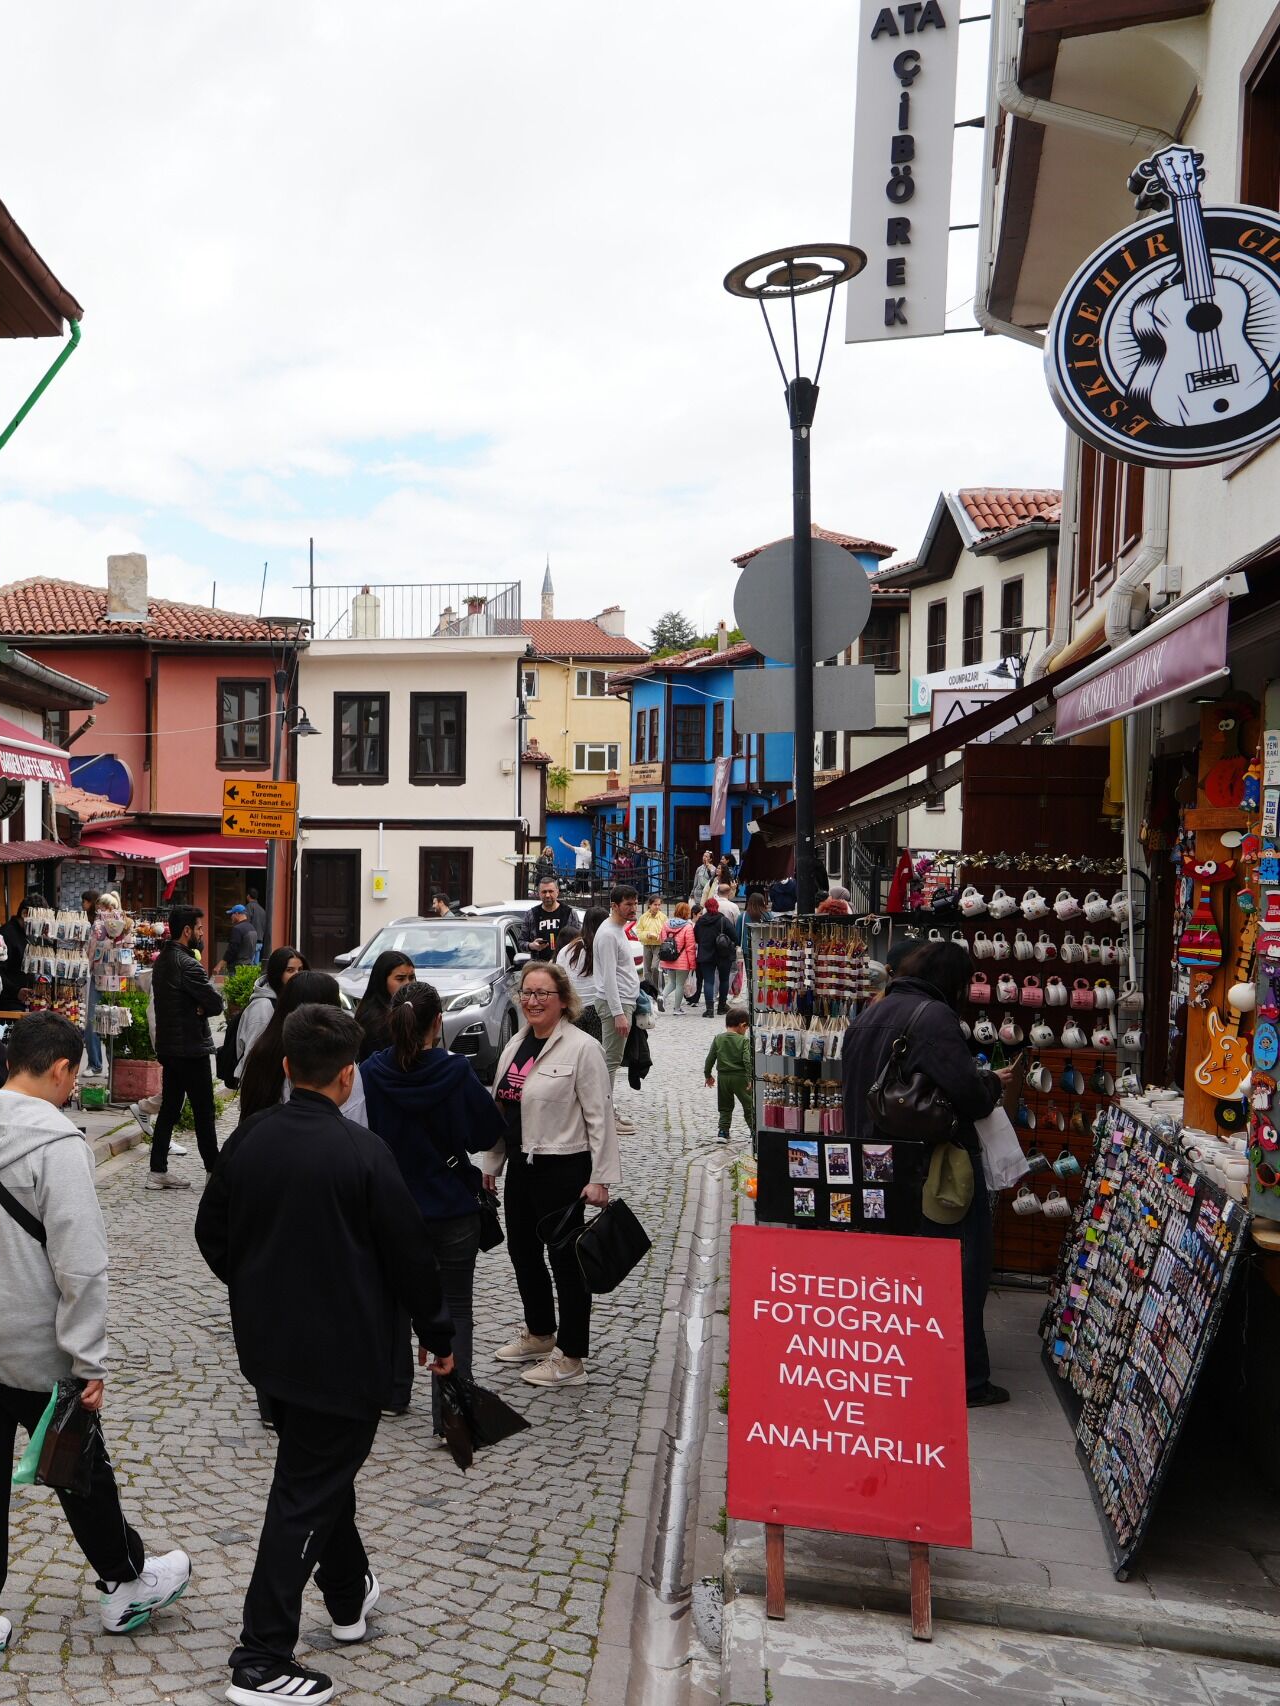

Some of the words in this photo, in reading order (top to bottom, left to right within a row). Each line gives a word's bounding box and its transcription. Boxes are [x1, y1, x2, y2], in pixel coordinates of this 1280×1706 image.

[870, 0, 946, 40] ATA
[884, 49, 921, 327] ÇİBÖREK
[1067, 232, 1172, 438] ESKİŞEHİR
[948, 671, 979, 686] ODUNPAZARI
[769, 1265, 924, 1308] İSTEDİĞİN
[785, 1333, 906, 1367] ANINDA
[778, 1363, 913, 1400] MAGNET
[823, 1398, 866, 1426] VE
[746, 1421, 947, 1470] ANAHTARLIK
